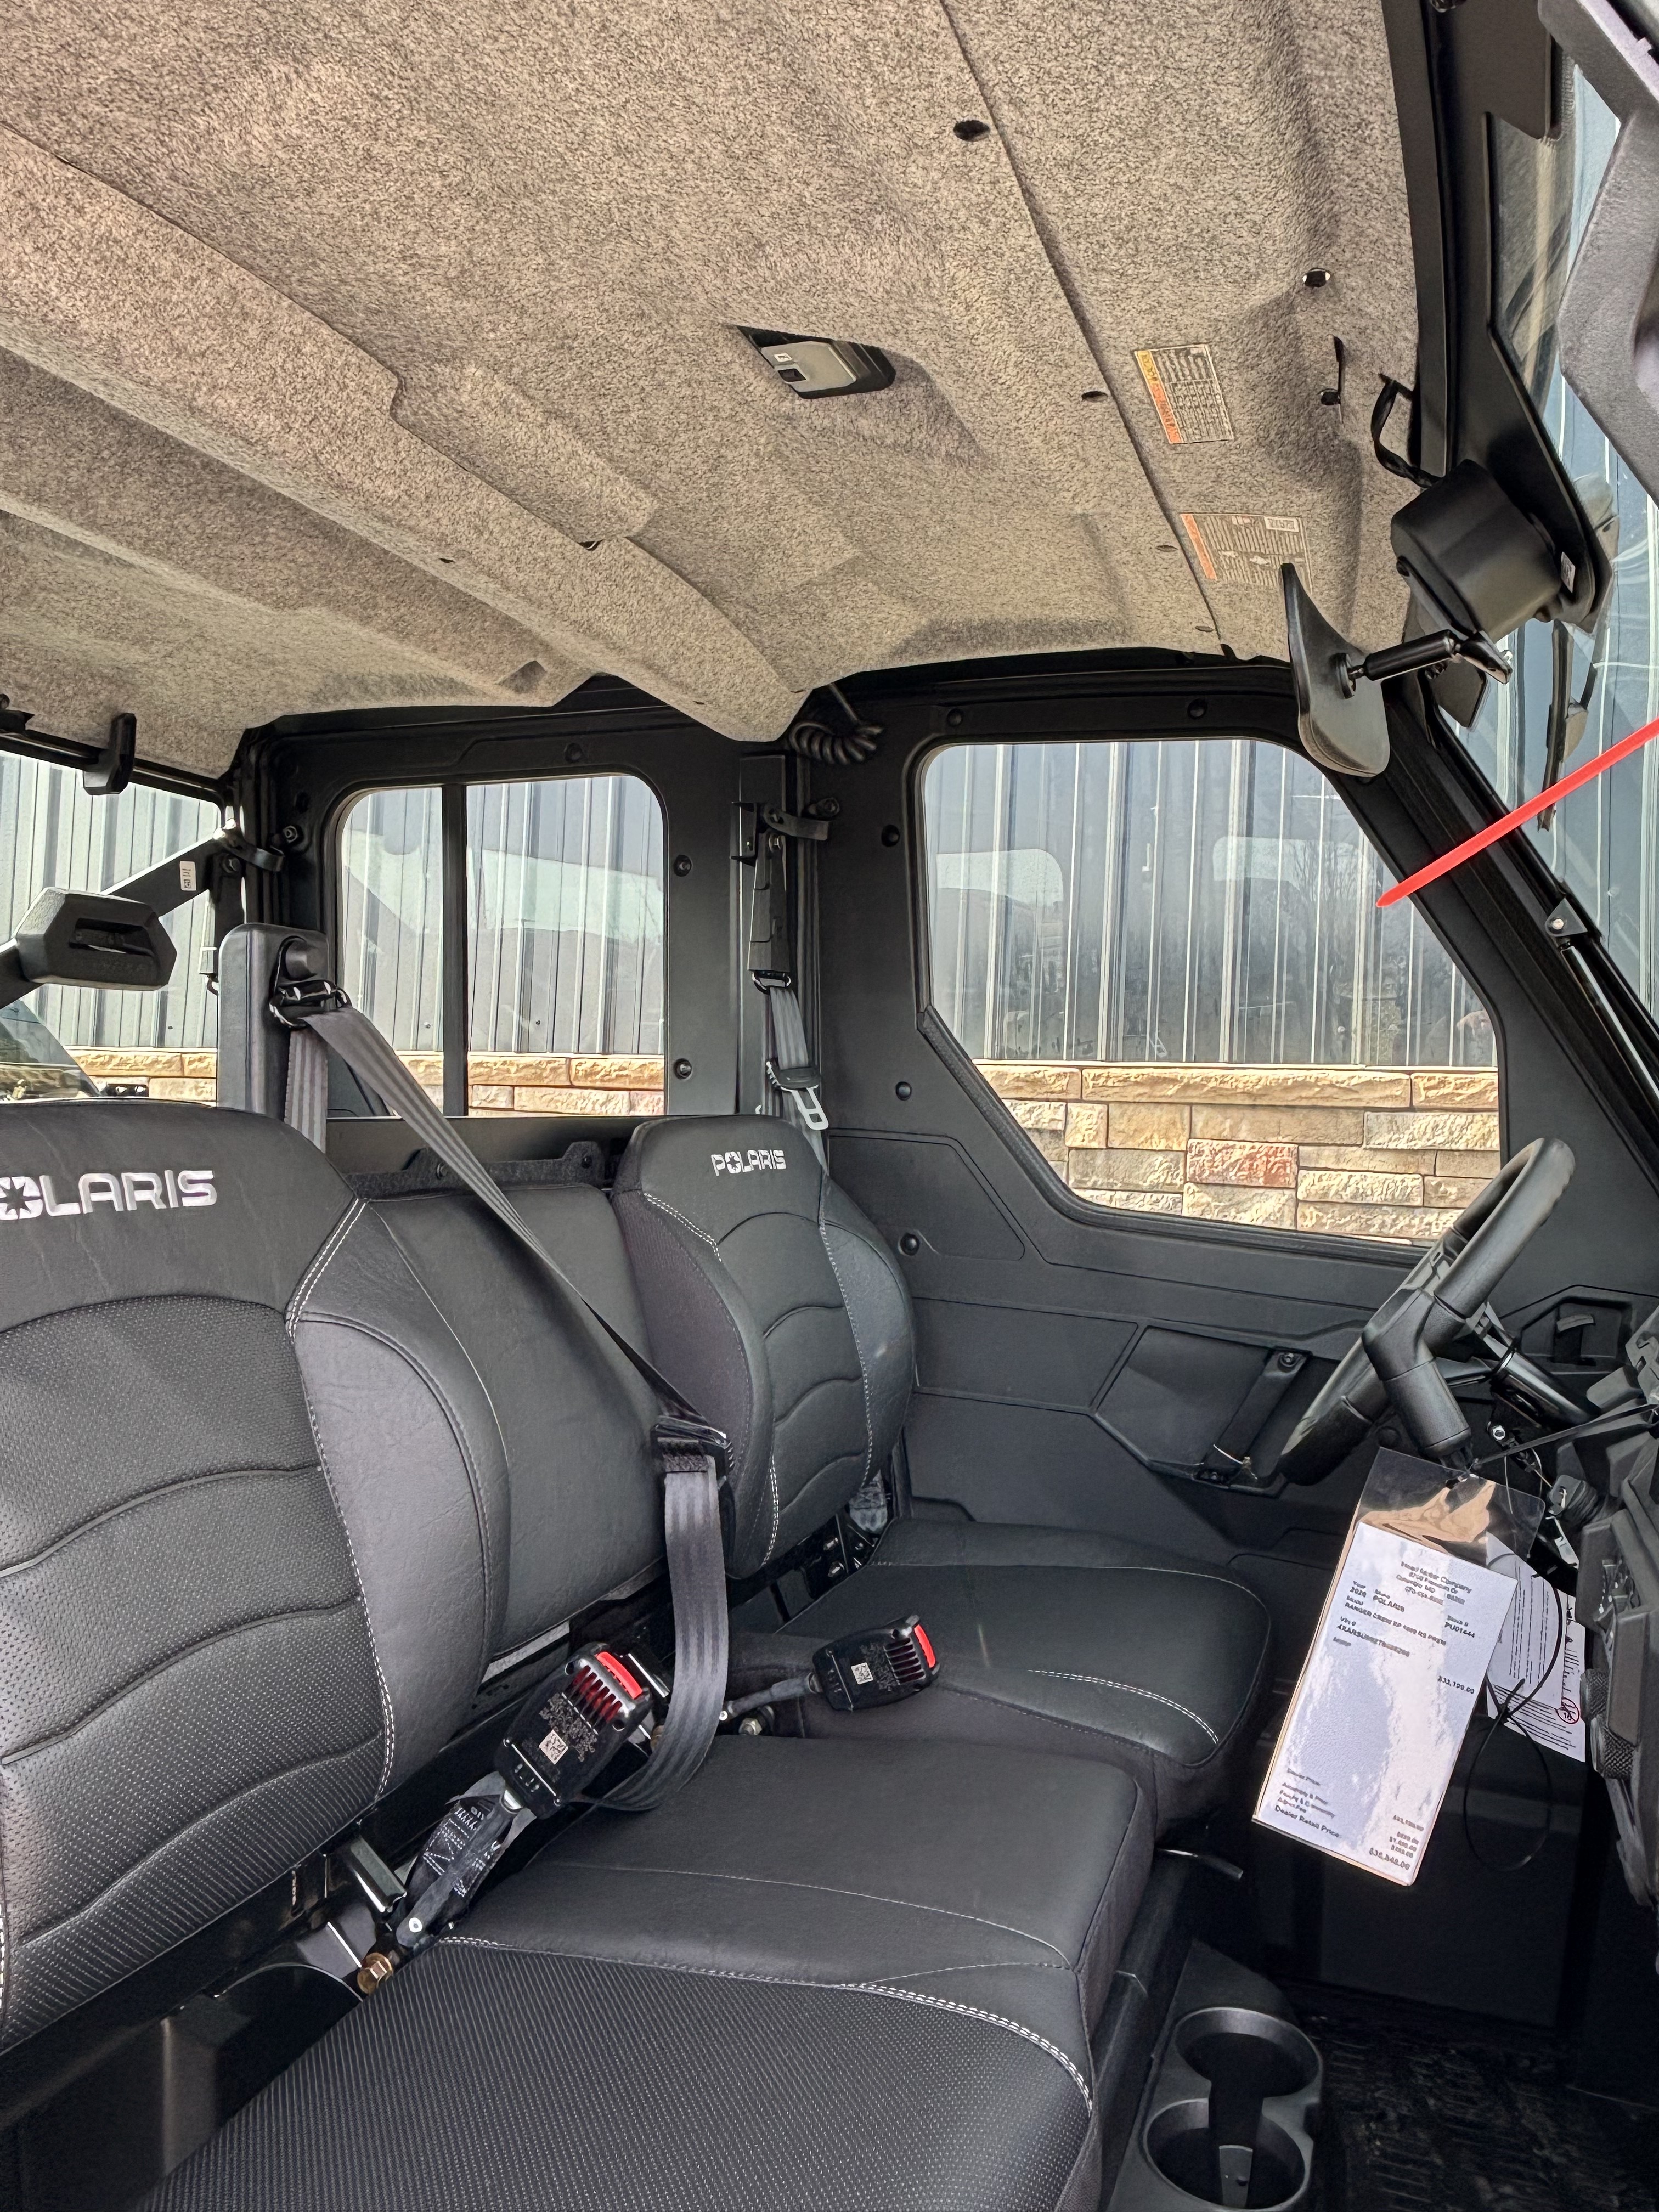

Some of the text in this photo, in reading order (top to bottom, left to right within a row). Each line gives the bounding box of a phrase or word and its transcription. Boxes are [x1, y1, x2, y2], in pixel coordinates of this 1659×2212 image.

[711, 1149, 786, 1176] POLARIS
[0, 1169, 217, 1221] OLARIS
[1321, 1825, 1339, 1837] Price
